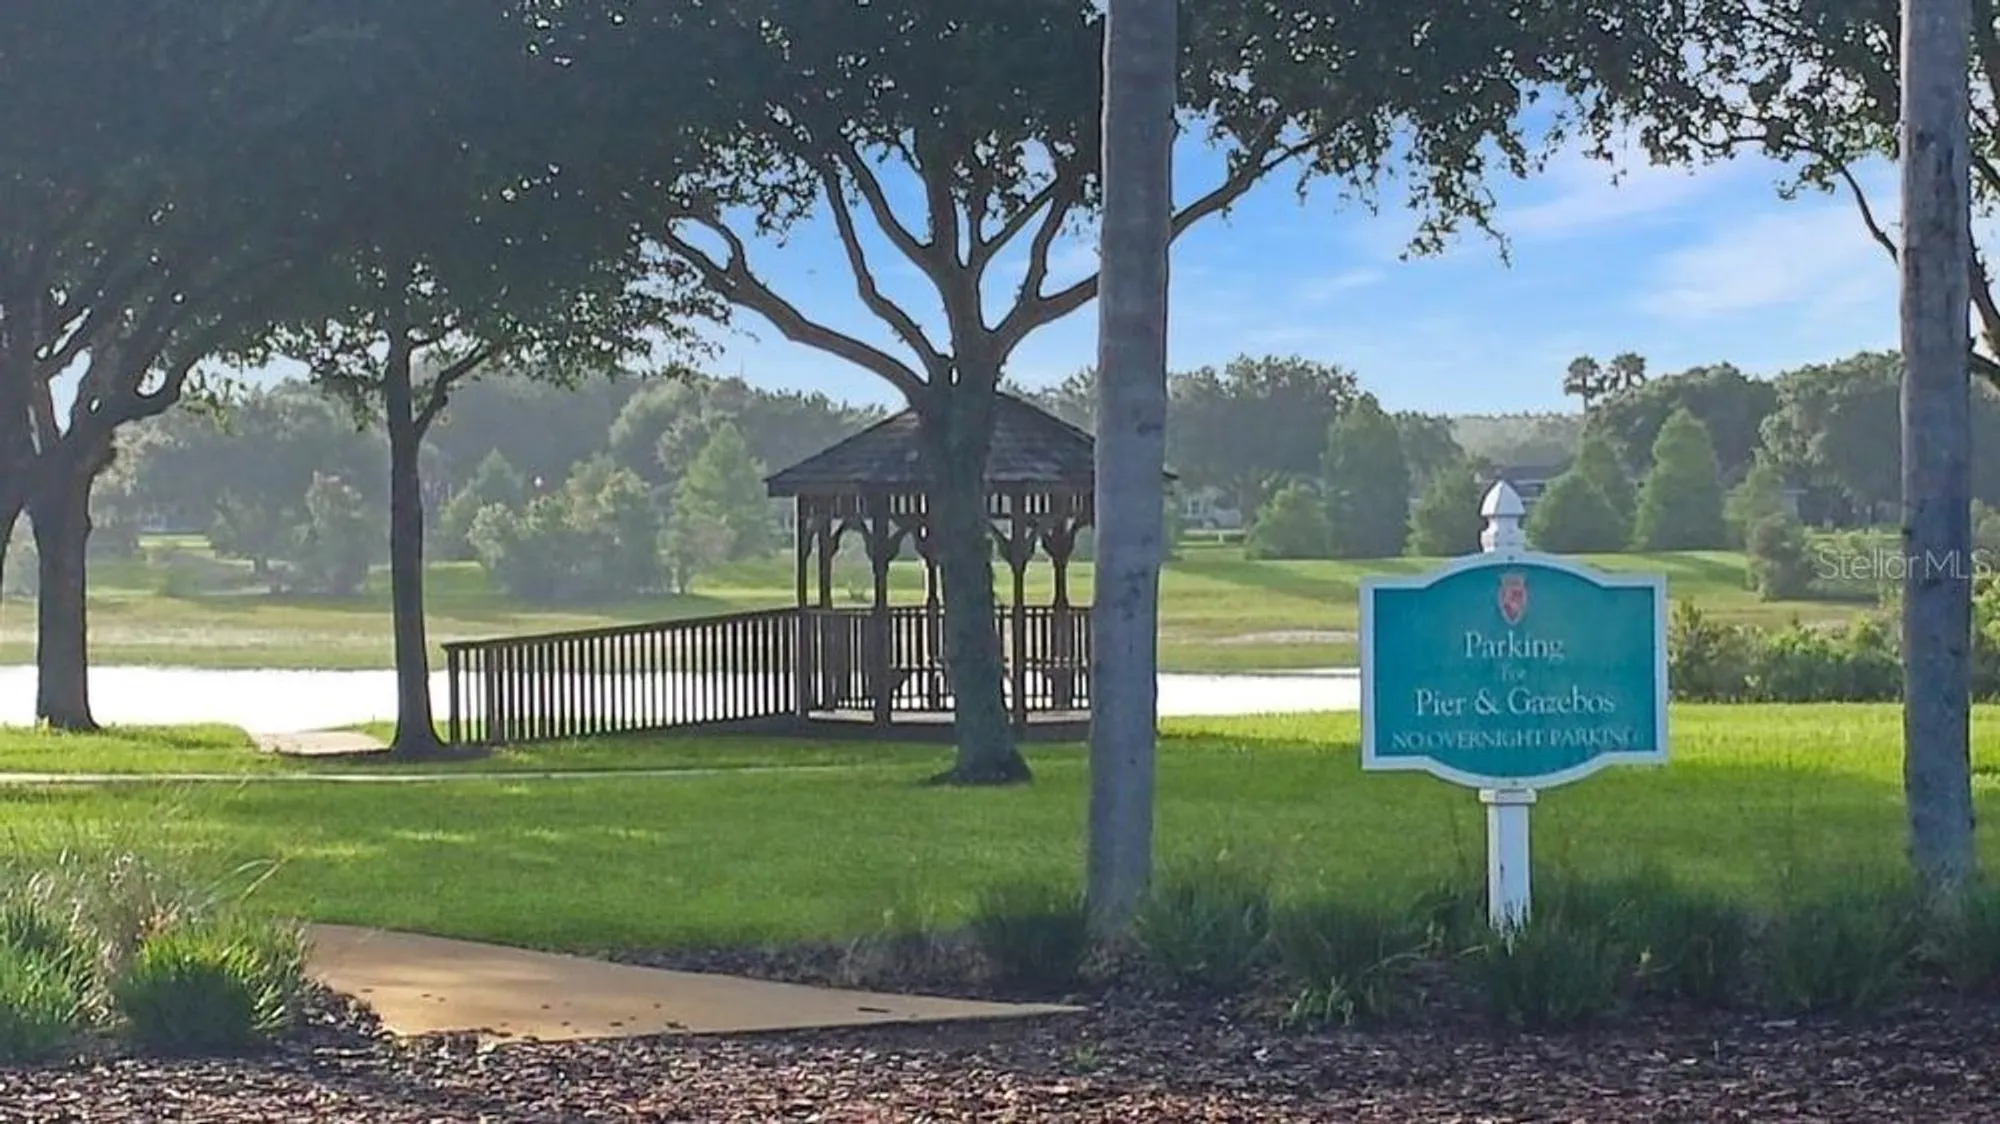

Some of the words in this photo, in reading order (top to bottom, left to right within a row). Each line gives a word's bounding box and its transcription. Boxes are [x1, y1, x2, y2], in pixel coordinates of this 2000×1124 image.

[1464, 629, 1565, 662] Parking
[1416, 688, 1466, 717] Pier
[1474, 688, 1499, 715] &
[1507, 685, 1615, 714] Gazebos
[1392, 732, 1424, 749] NO
[1427, 729, 1544, 749] OVERNIGHT
